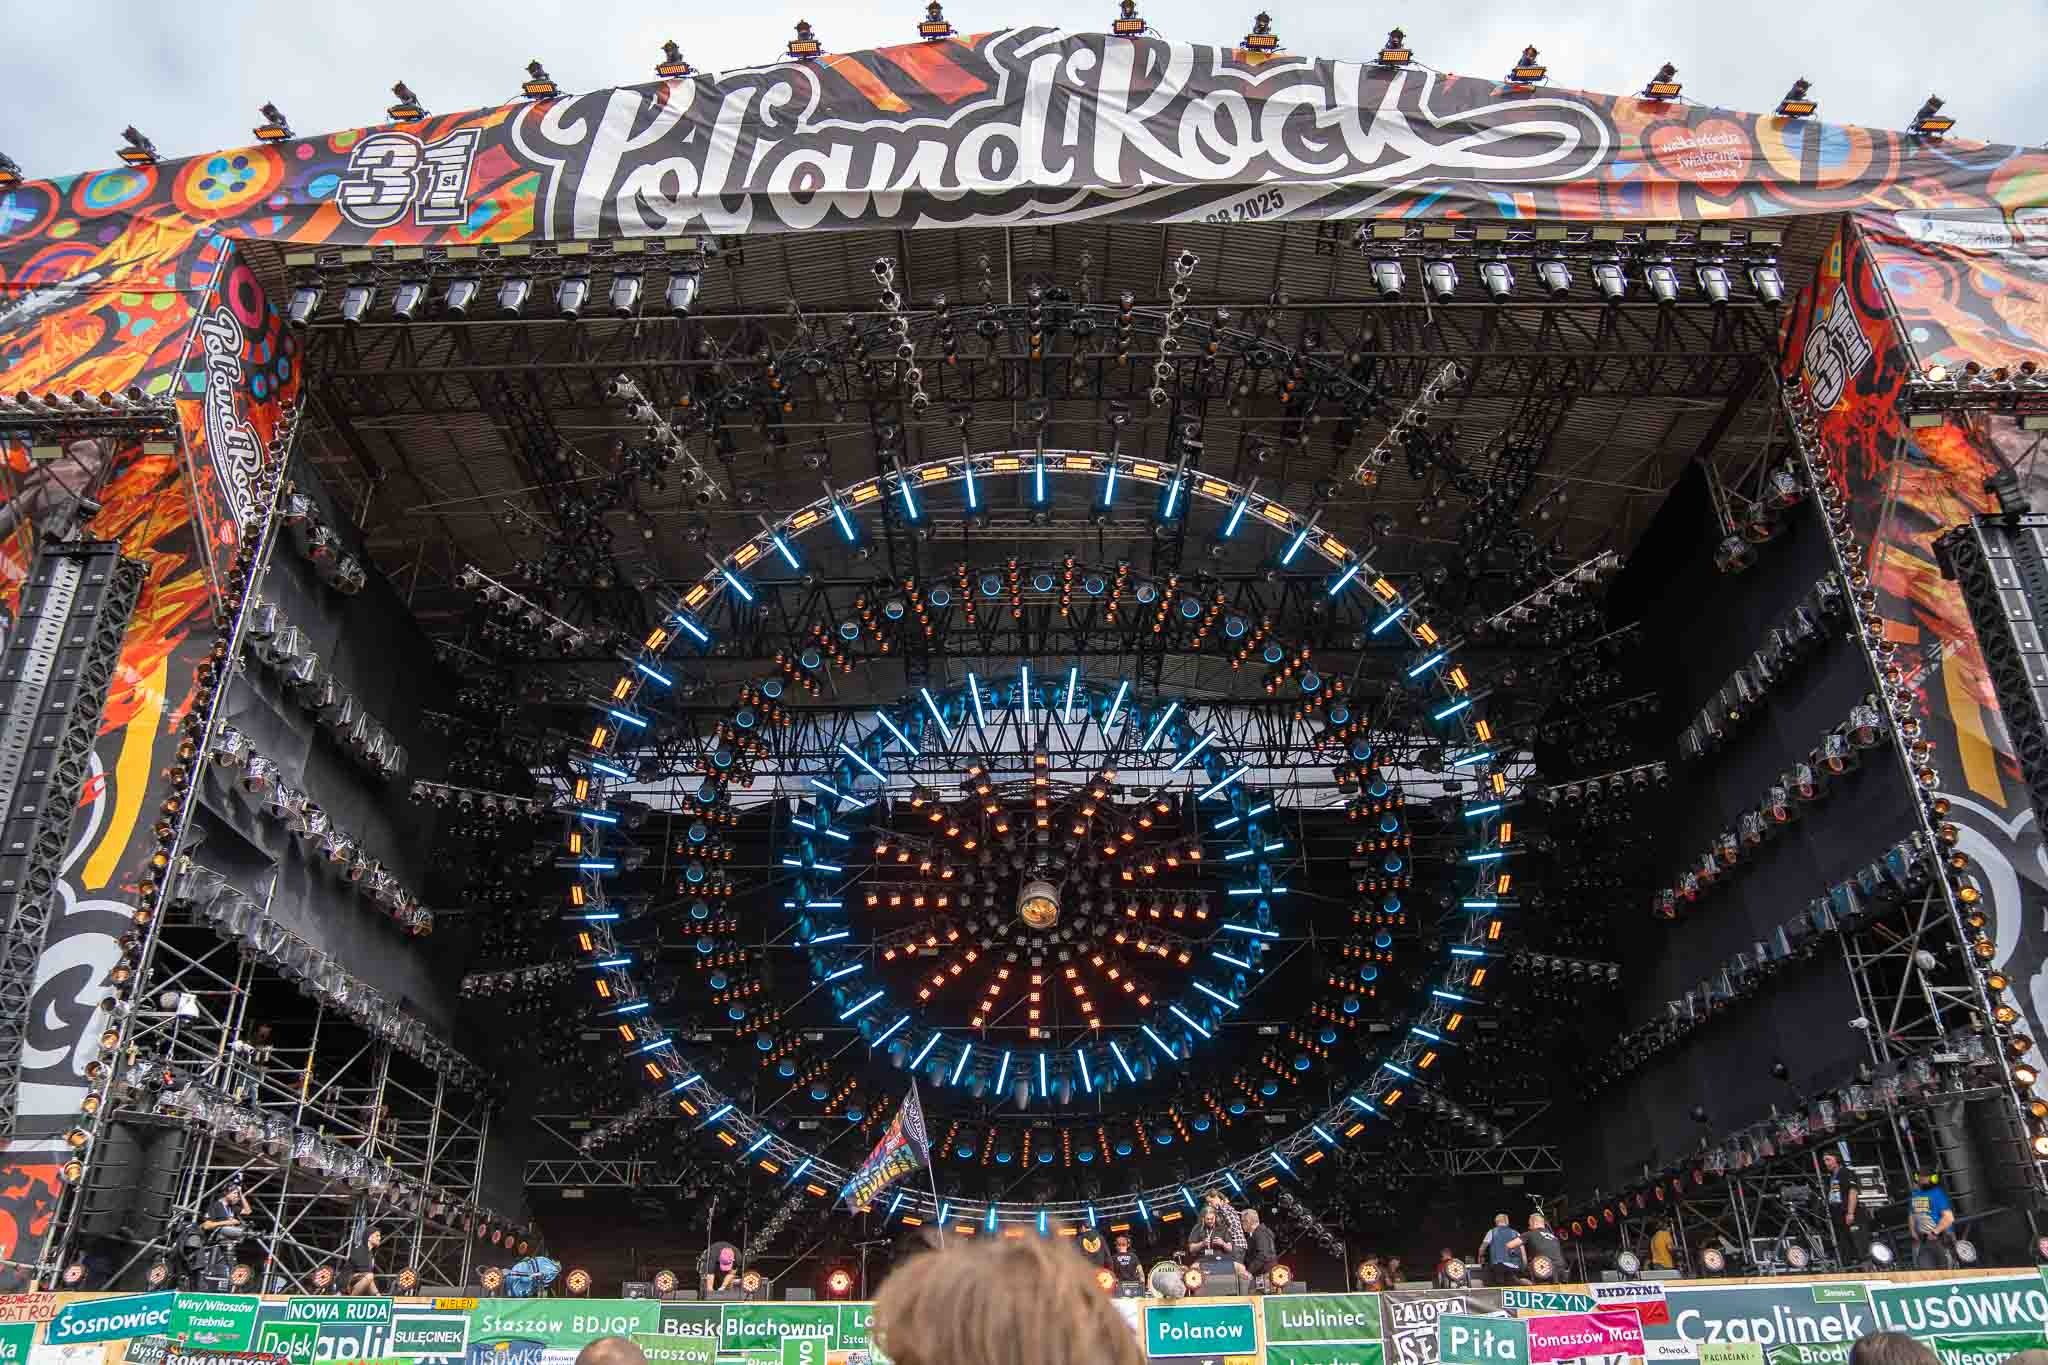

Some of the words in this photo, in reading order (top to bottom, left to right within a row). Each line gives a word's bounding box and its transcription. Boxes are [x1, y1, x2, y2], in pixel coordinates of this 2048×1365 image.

[1503, 1290, 1588, 1311] BURZYN
[1596, 1286, 1662, 1298] RYDZYNA
[290, 1303, 339, 1321] NOWA
[346, 1304, 388, 1321] RUDA
[1282, 1309, 1366, 1329] Lubliniec
[1880, 1286, 2048, 1332] LUSÓWKO
[57, 1306, 170, 1338] Sosnowiec
[188, 1315, 235, 1328] Trzebnica
[481, 1315, 564, 1335] Staszów
[726, 1316, 834, 1337] Blachownia
[1159, 1321, 1243, 1342] Polanów
[1676, 1302, 1865, 1346] Czaplinek
[262, 1331, 312, 1360] Dolsk
[395, 1332, 462, 1346] SULĘCINEK
[1451, 1326, 1516, 1361] Piła
[1529, 1331, 1603, 1348] Tomaszów
